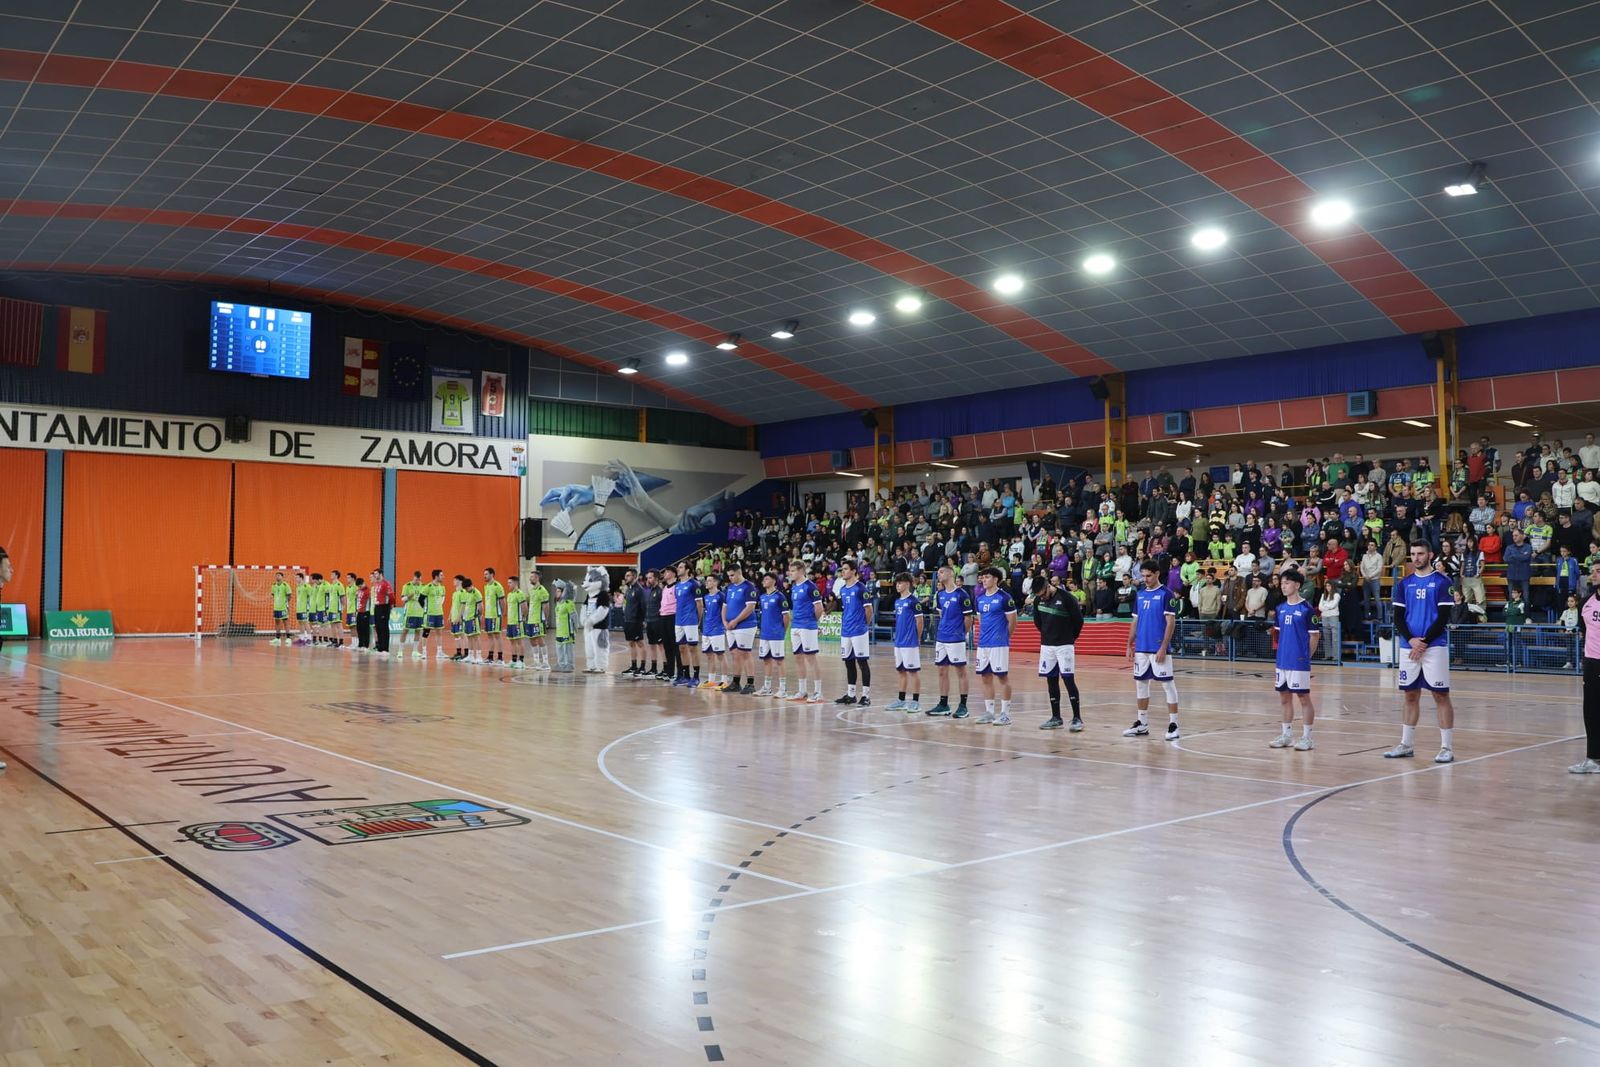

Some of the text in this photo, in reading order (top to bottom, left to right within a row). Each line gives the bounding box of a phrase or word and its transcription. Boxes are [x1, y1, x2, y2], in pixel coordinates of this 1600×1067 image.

[269, 429, 315, 460] DE
[360, 435, 502, 470] ZAMORA
[1416, 588, 1427, 600] 98
[1143, 600, 1151, 610] 71
[1284, 614, 1293, 625] 81
[1592, 610, 1600, 622] 9
[50, 627, 113, 638] CAJA RURAL
